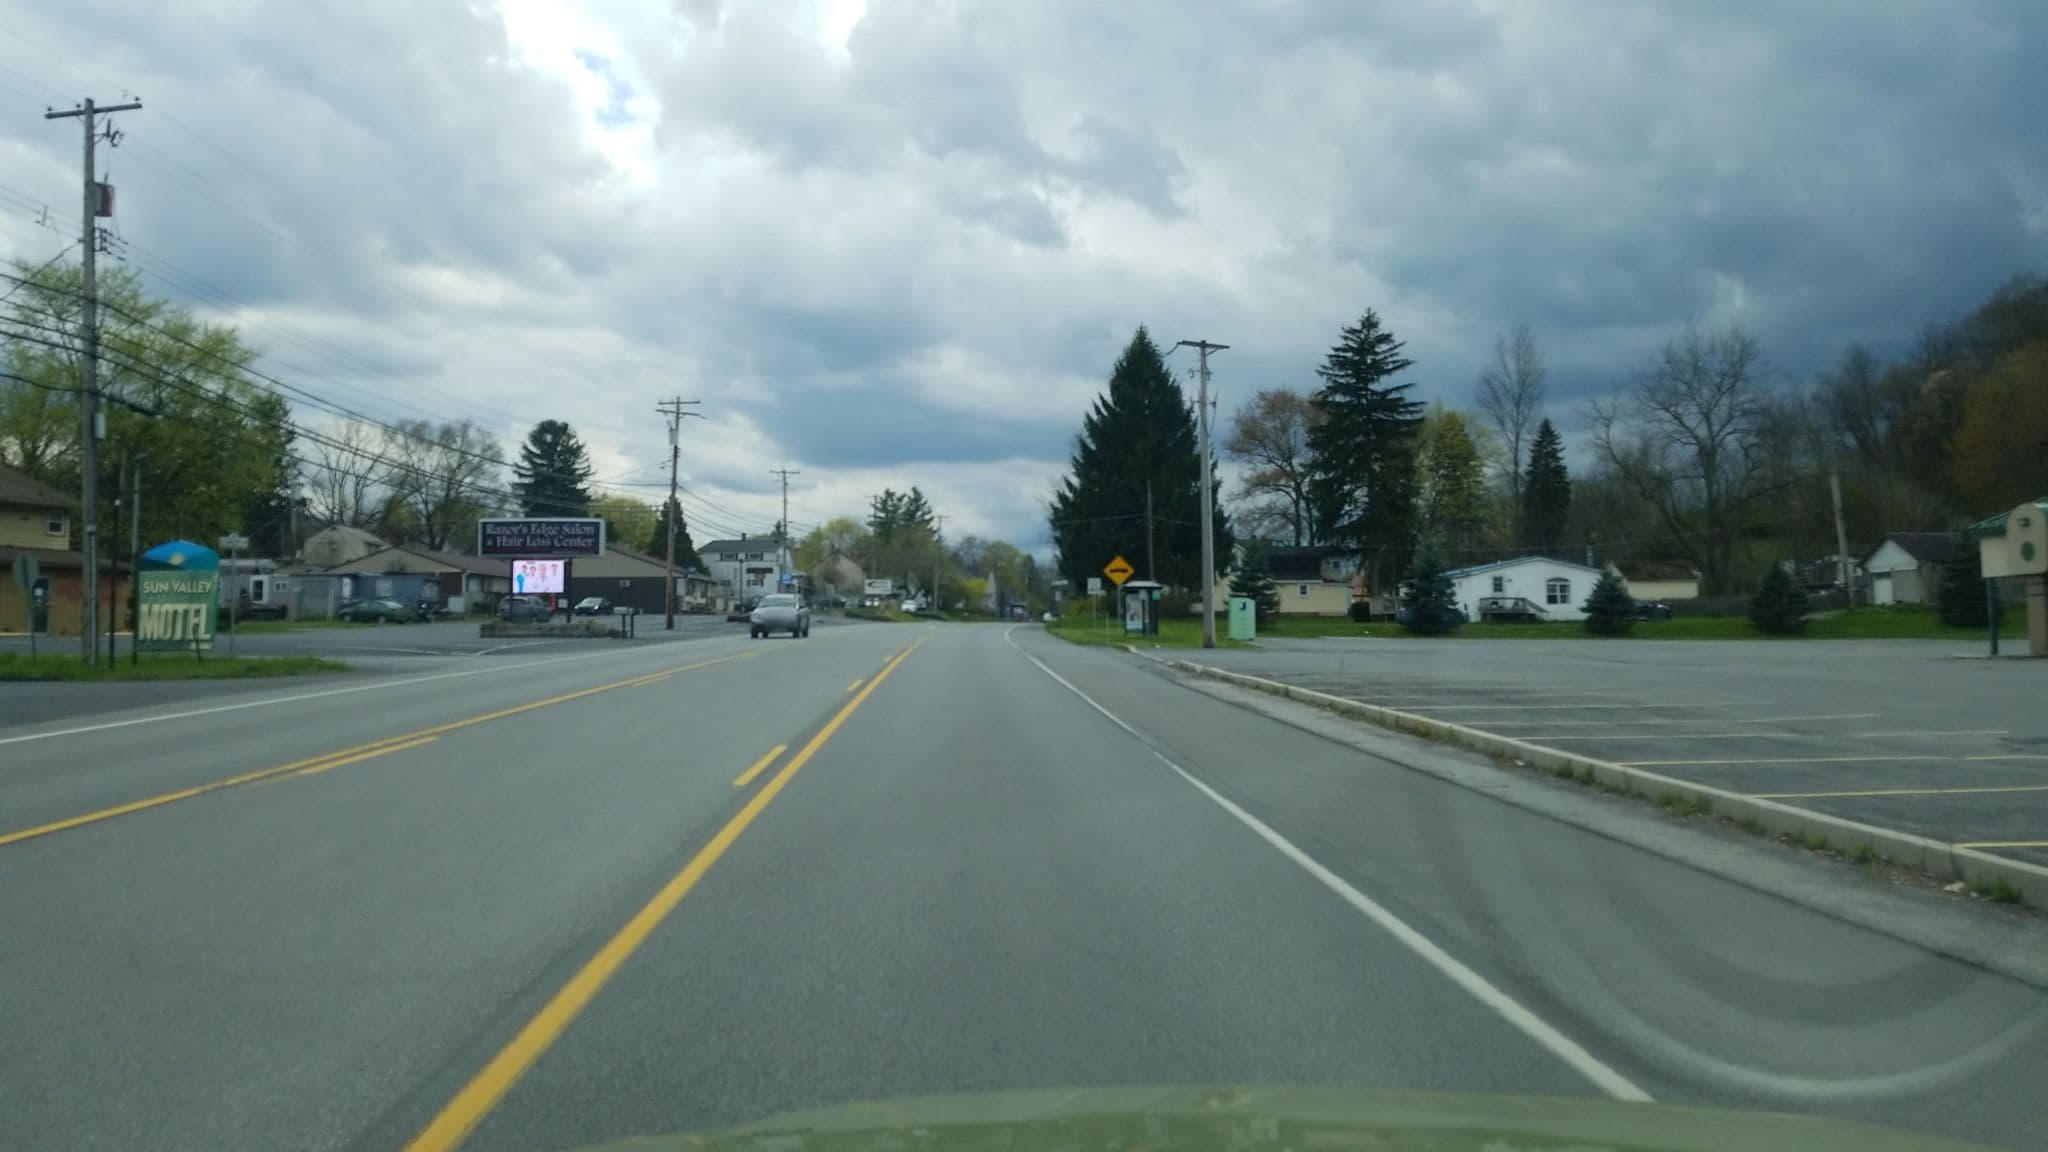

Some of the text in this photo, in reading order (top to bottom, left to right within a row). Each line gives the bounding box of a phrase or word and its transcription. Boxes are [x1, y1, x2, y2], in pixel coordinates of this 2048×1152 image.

[530, 523, 559, 537] Edge
[562, 523, 595, 535] Salon
[496, 535, 523, 547] Hair
[526, 535, 551, 546] Loss
[553, 535, 593, 547] Center
[143, 580, 212, 594] SUN VALLEY
[139, 603, 212, 641] MOTEL
